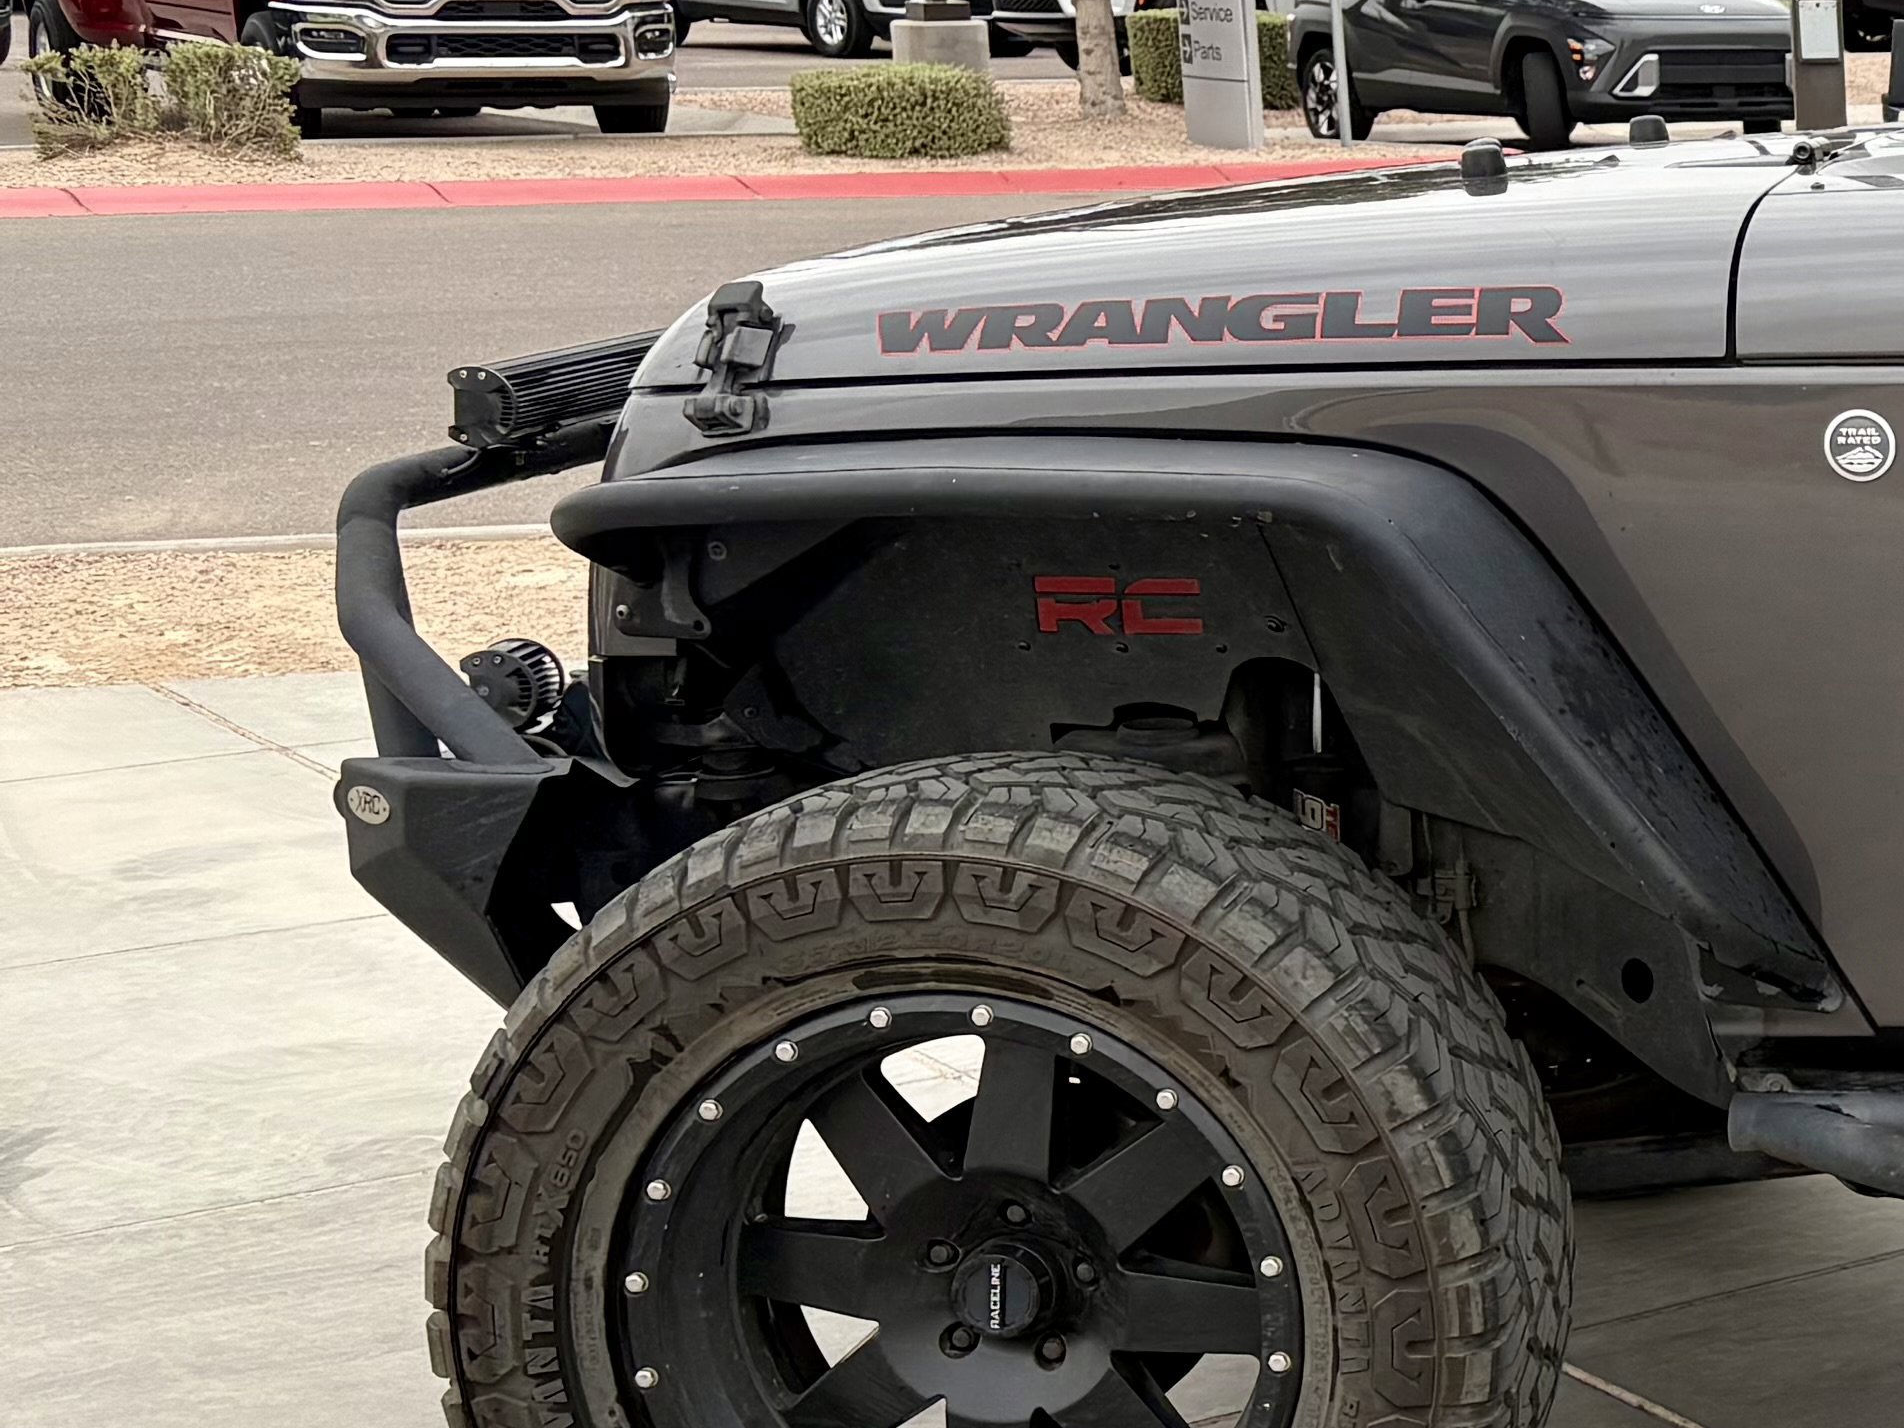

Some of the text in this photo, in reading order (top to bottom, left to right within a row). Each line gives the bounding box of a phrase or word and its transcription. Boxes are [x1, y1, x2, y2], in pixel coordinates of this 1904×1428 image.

[1191, 1, 1233, 23] Service
[1193, 40, 1222, 61] Parts
[877, 285, 1571, 354] WRANGLER
[1837, 436, 1882, 445] RATED
[1839, 427, 1880, 436] TRAIL
[1034, 576, 1203, 635] RC
[1293, 1168, 1369, 1374] ADVANTA
[990, 1264, 1000, 1329] RACELINE
